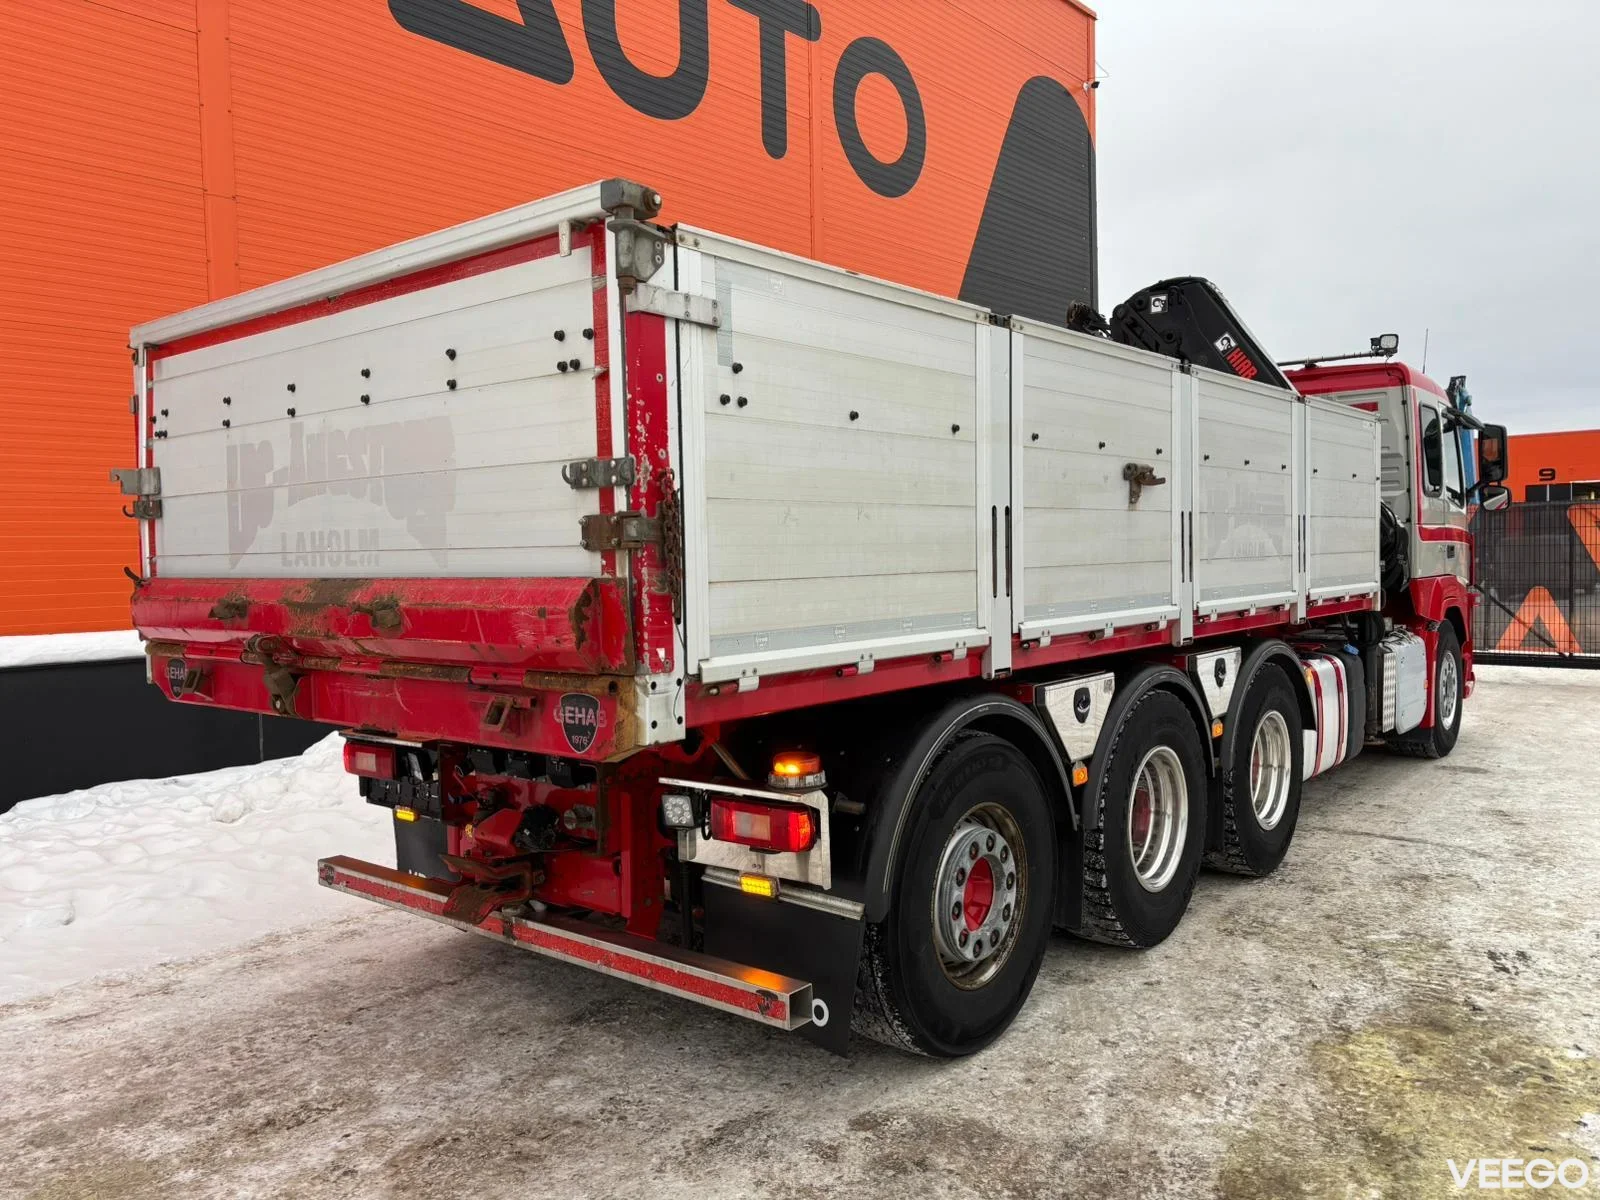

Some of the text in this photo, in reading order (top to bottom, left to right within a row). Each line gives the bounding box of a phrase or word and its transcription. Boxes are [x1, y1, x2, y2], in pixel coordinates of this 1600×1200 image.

[1538, 468, 1556, 481] 9
[280, 528, 381, 568] LAHOLM
[553, 705, 607, 727] GEHAB
